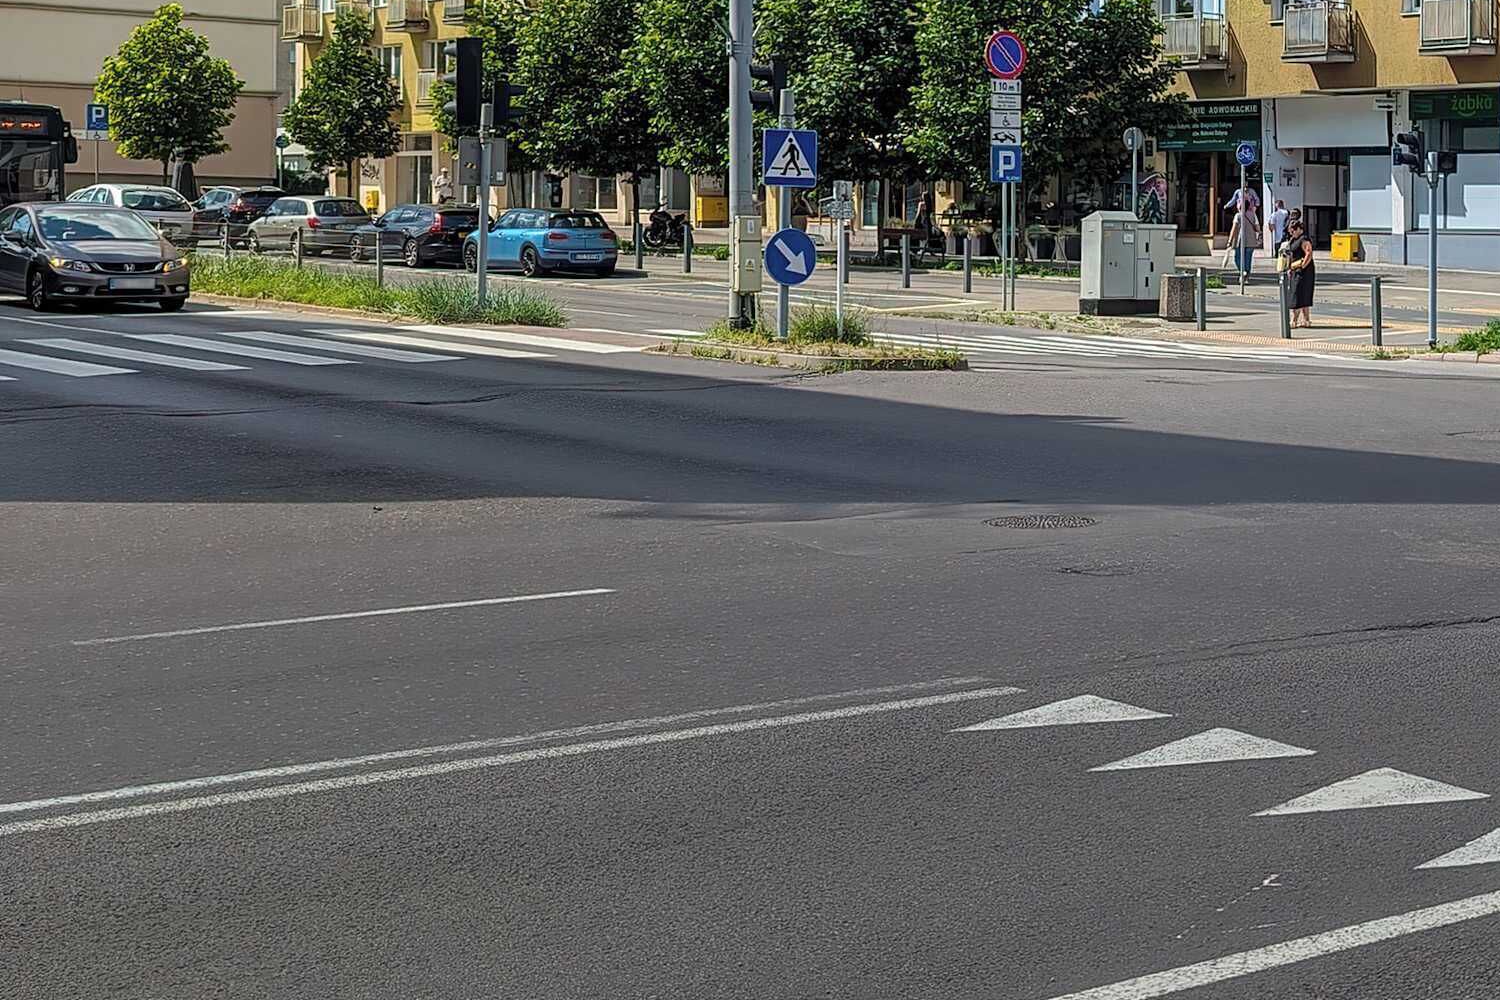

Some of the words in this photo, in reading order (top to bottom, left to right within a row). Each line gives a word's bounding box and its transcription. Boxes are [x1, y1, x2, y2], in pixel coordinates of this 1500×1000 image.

[1208, 105, 1258, 115] ADWOKACKIE
[1449, 94, 1494, 111] żabka
[92, 107, 105, 122] P
[998, 151, 1016, 178] P
